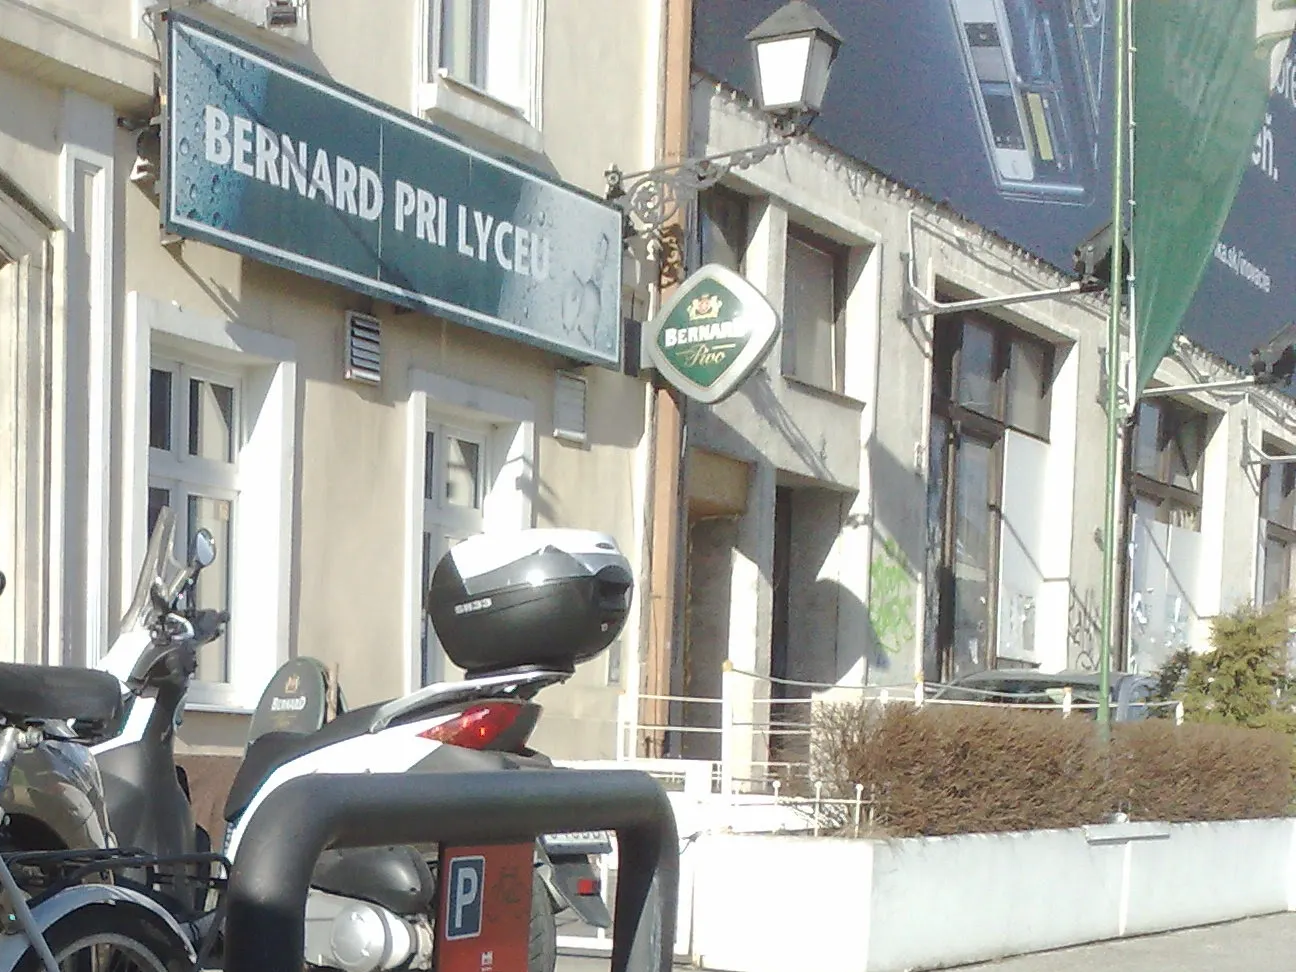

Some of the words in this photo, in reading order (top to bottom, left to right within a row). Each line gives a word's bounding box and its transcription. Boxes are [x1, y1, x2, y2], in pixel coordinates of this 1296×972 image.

[204, 105, 384, 221] BERNARD
[394, 180, 448, 247] PRI
[457, 205, 551, 280] LYCEU
[454, 866, 478, 929] P
